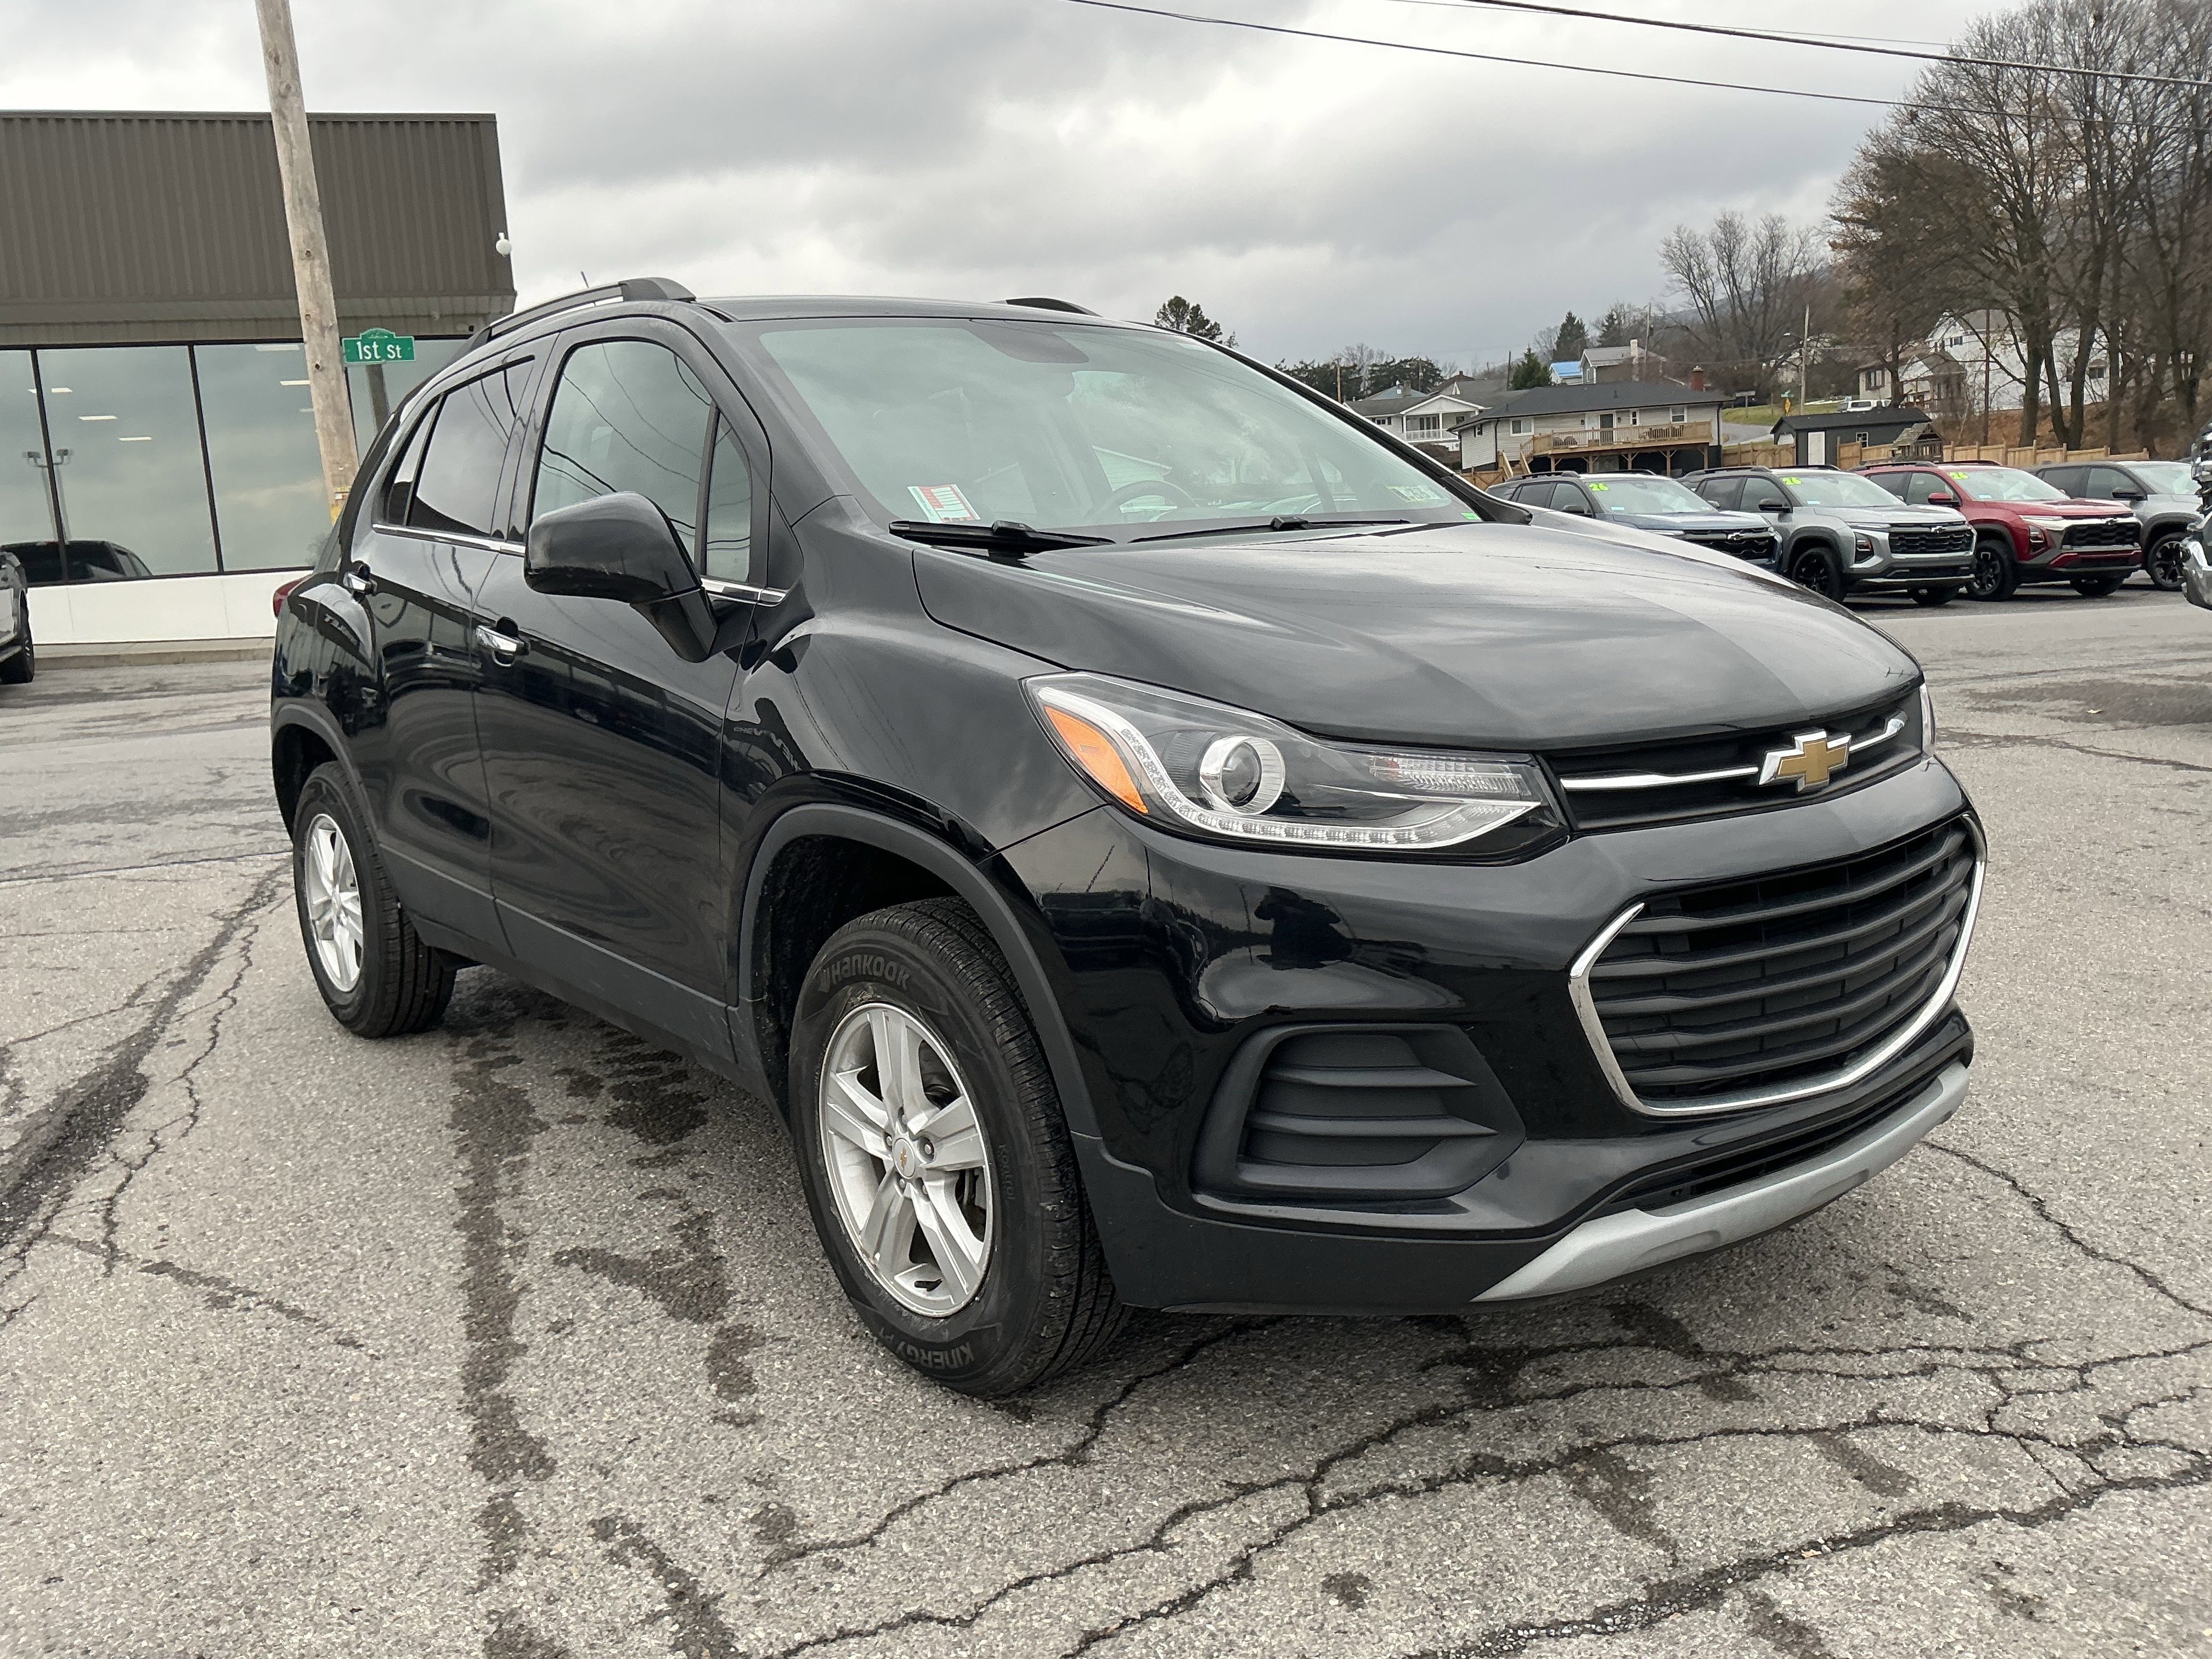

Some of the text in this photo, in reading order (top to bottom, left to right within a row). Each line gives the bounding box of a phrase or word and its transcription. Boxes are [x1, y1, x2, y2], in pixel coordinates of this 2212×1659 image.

[357, 341, 402, 360] 1st St
[1782, 477, 1802, 485] 26
[1589, 483, 1609, 491] 26
